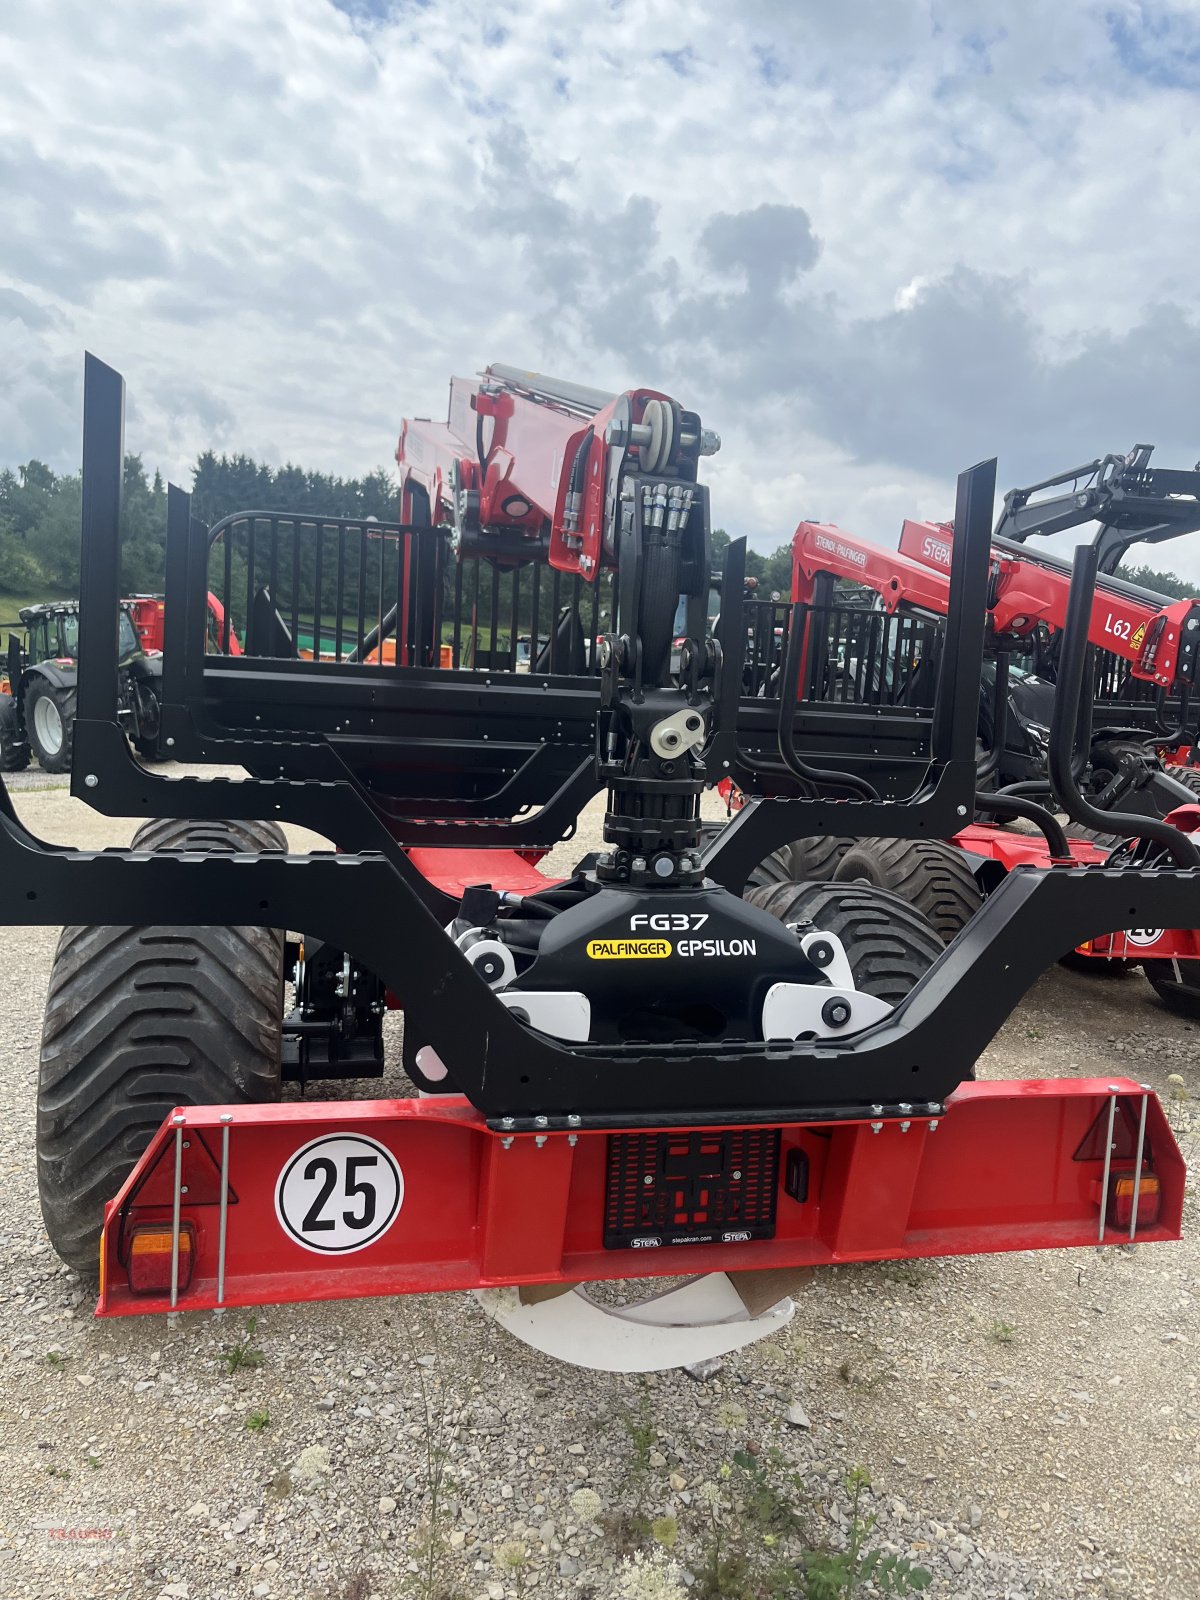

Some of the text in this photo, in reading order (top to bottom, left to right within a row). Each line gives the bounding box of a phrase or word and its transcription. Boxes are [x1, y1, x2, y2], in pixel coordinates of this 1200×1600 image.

[923, 537, 951, 566] STEPA
[1104, 613, 1131, 640] L62
[630, 913, 709, 931] FG37
[592, 939, 757, 957] PALFINGER EPSILON
[302, 1156, 378, 1232] 25
[632, 1232, 749, 1248] STEPA stepakran.com STEPA
